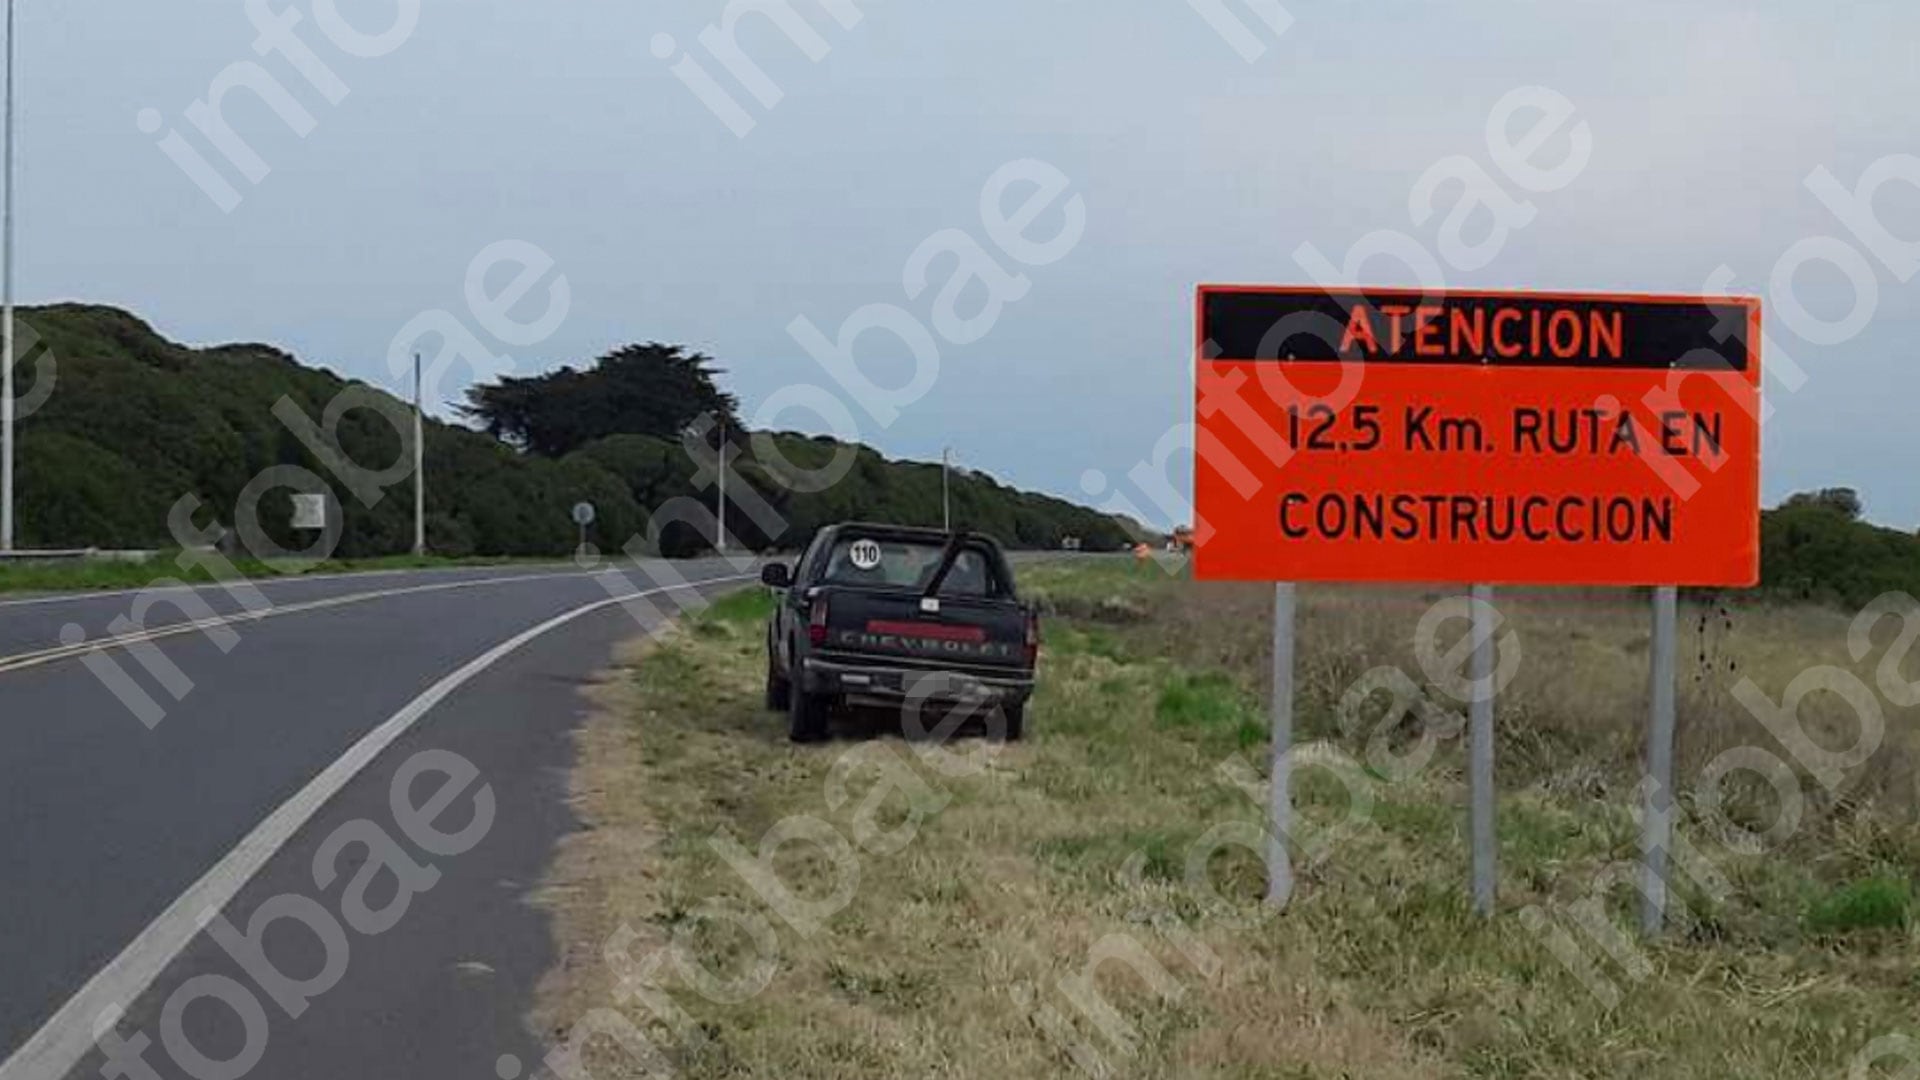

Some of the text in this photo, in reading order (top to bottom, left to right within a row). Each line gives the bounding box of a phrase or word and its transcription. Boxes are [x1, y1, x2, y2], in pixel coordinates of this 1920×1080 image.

[1341, 304, 1623, 359] ATENCION
[1404, 406, 1494, 453] Km.
[1512, 408, 1641, 455] RUTA
[1661, 411, 1721, 457] EN
[1280, 492, 1673, 543] CONSTRUCCION
[853, 545, 878, 563] 110
